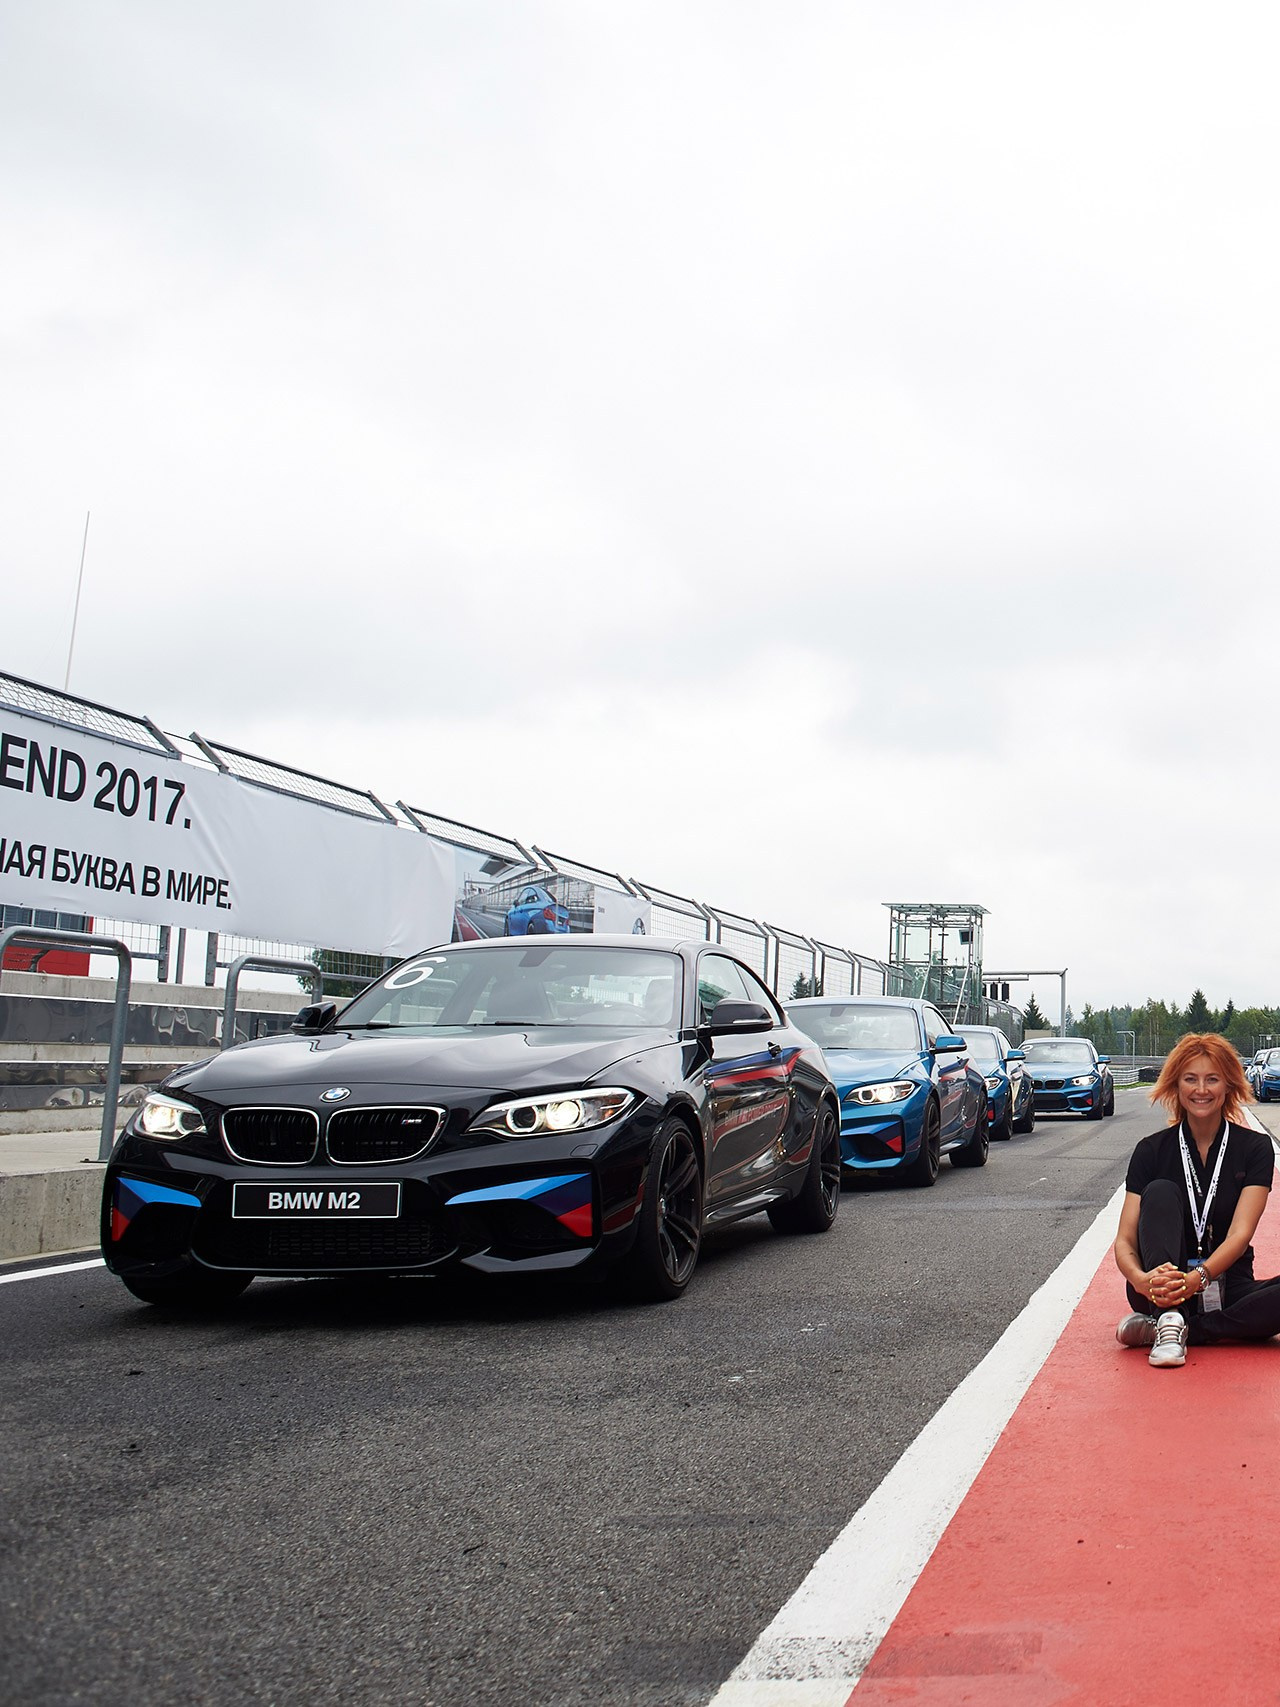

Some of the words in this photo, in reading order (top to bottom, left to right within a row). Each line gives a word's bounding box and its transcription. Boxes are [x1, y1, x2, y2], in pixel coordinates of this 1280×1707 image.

[0, 732, 86, 802] END
[93, 761, 191, 829] 2017.
[51, 848, 135, 895] БУКВА
[141, 865, 161, 897] В
[166, 869, 232, 910] МИРЕ.
[384, 957, 447, 989] 6
[268, 1192, 323, 1210] BMW
[327, 1192, 361, 1210] M2
